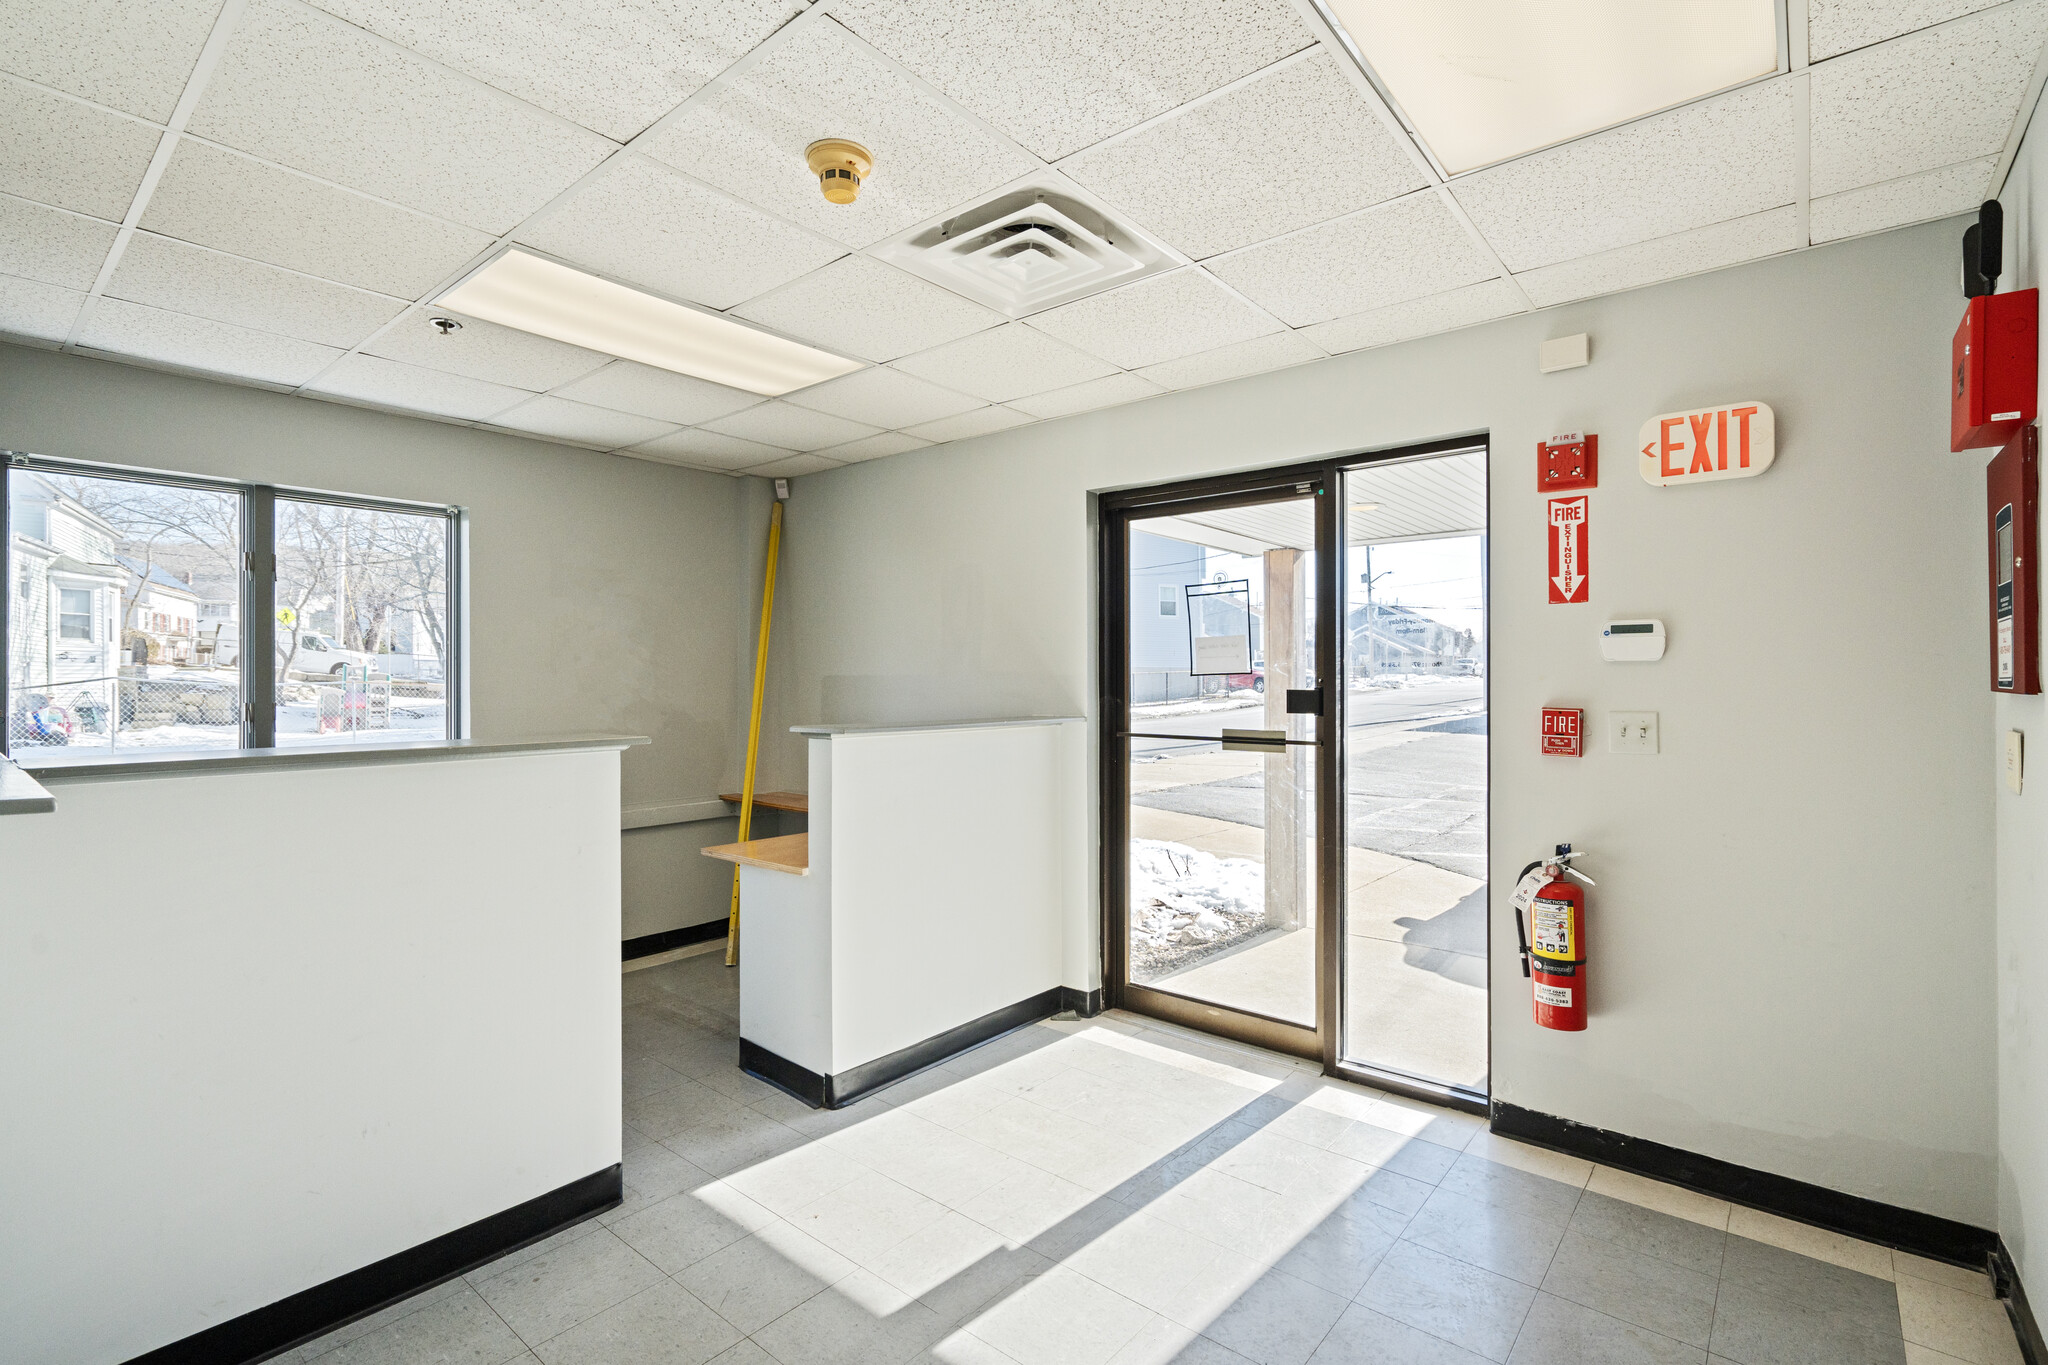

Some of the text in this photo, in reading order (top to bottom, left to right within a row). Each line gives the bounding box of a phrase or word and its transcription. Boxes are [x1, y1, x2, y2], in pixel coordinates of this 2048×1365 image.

[1552, 433, 1577, 442] FIRE
[1660, 406, 1758, 478] EXIT
[1554, 505, 1582, 522] FIRE
[1564, 523, 1573, 593] EXTINGUISHER
[1544, 715, 1576, 734] FIRE
